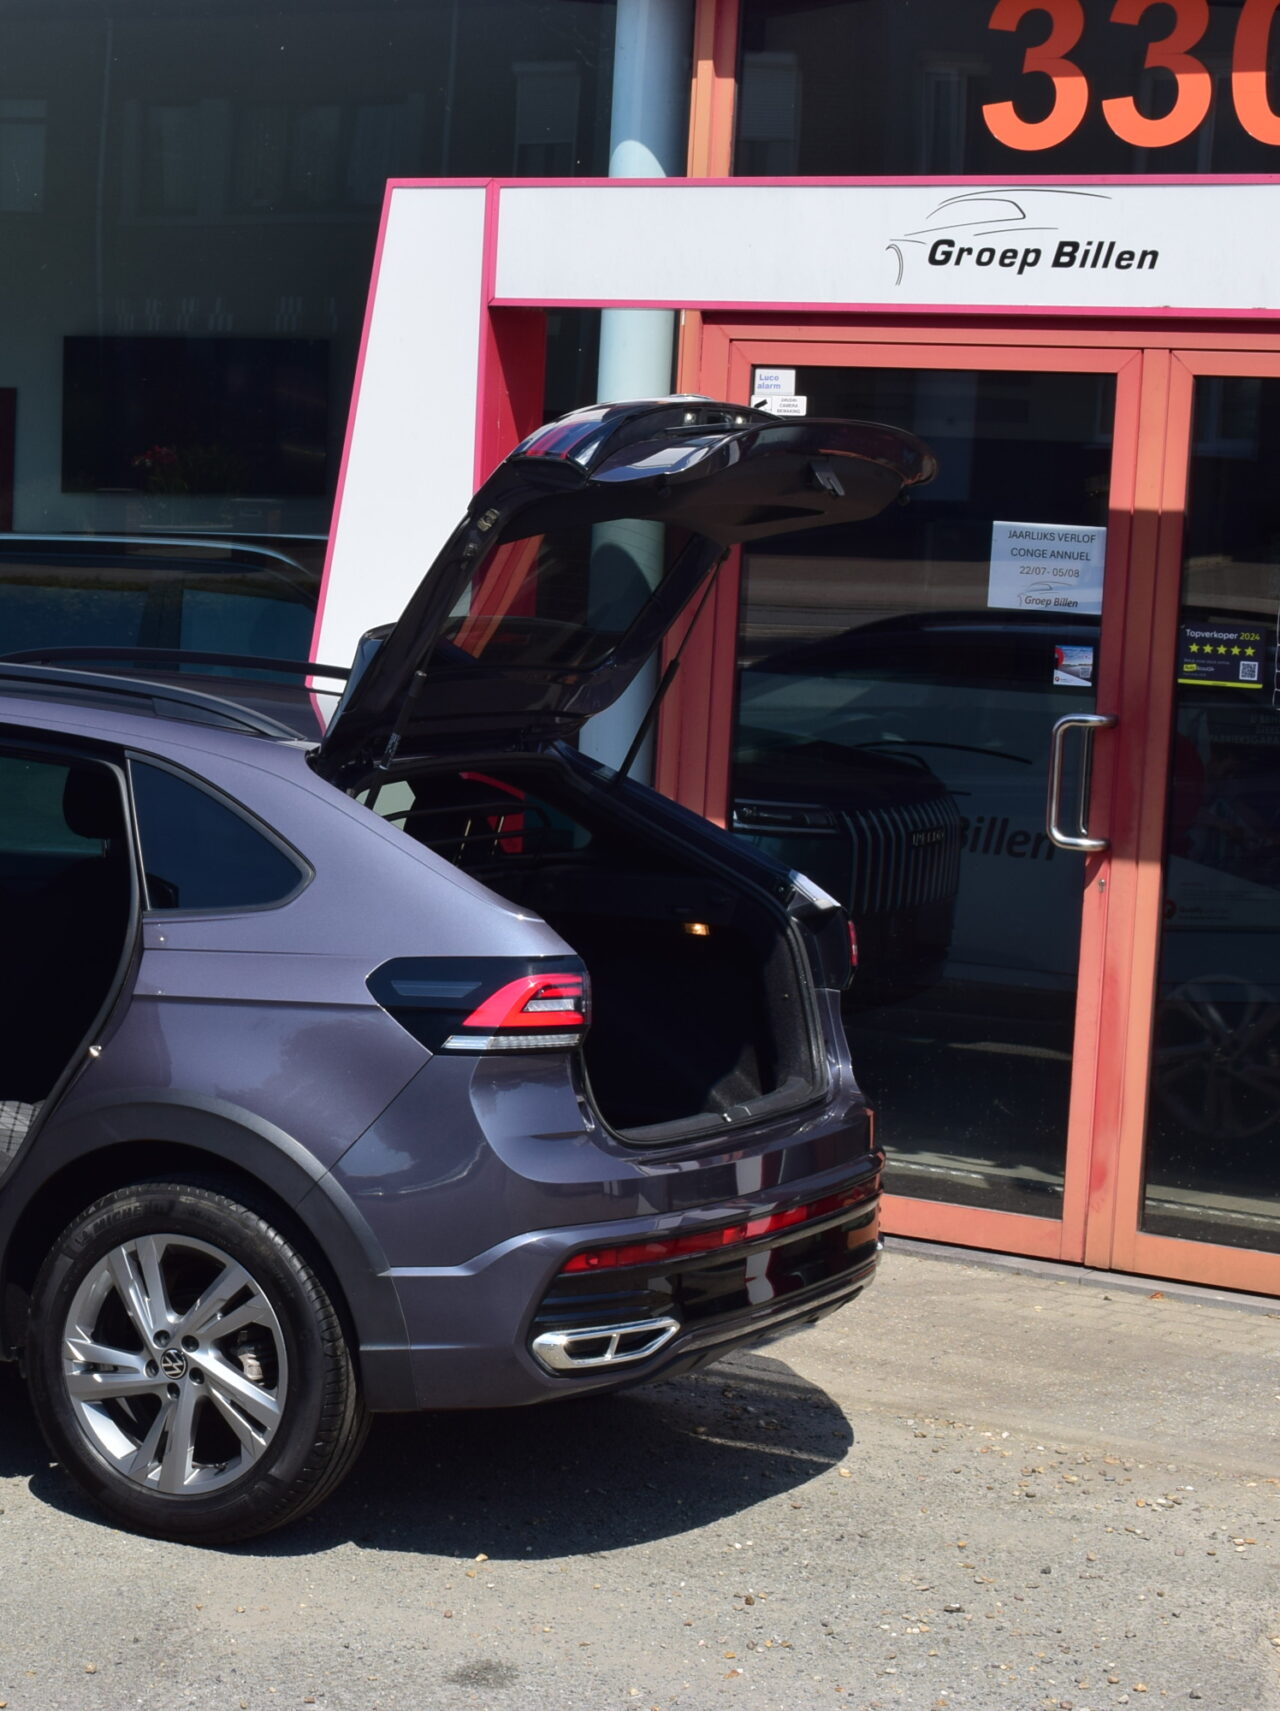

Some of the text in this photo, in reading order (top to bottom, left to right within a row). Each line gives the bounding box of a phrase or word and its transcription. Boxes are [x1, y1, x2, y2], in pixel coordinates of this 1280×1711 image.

[927, 238, 1160, 276] Groep Billen
[759, 373, 780, 382] Luco
[1008, 530, 1097, 544] JAARLIJKS VERLOF
[1010, 547, 1092, 561] CONGE ANNUEL
[1052, 567, 1080, 578] 05/08
[1024, 595, 1079, 608] Groep Billen
[1186, 628, 1261, 641] Topverkoper 2024
